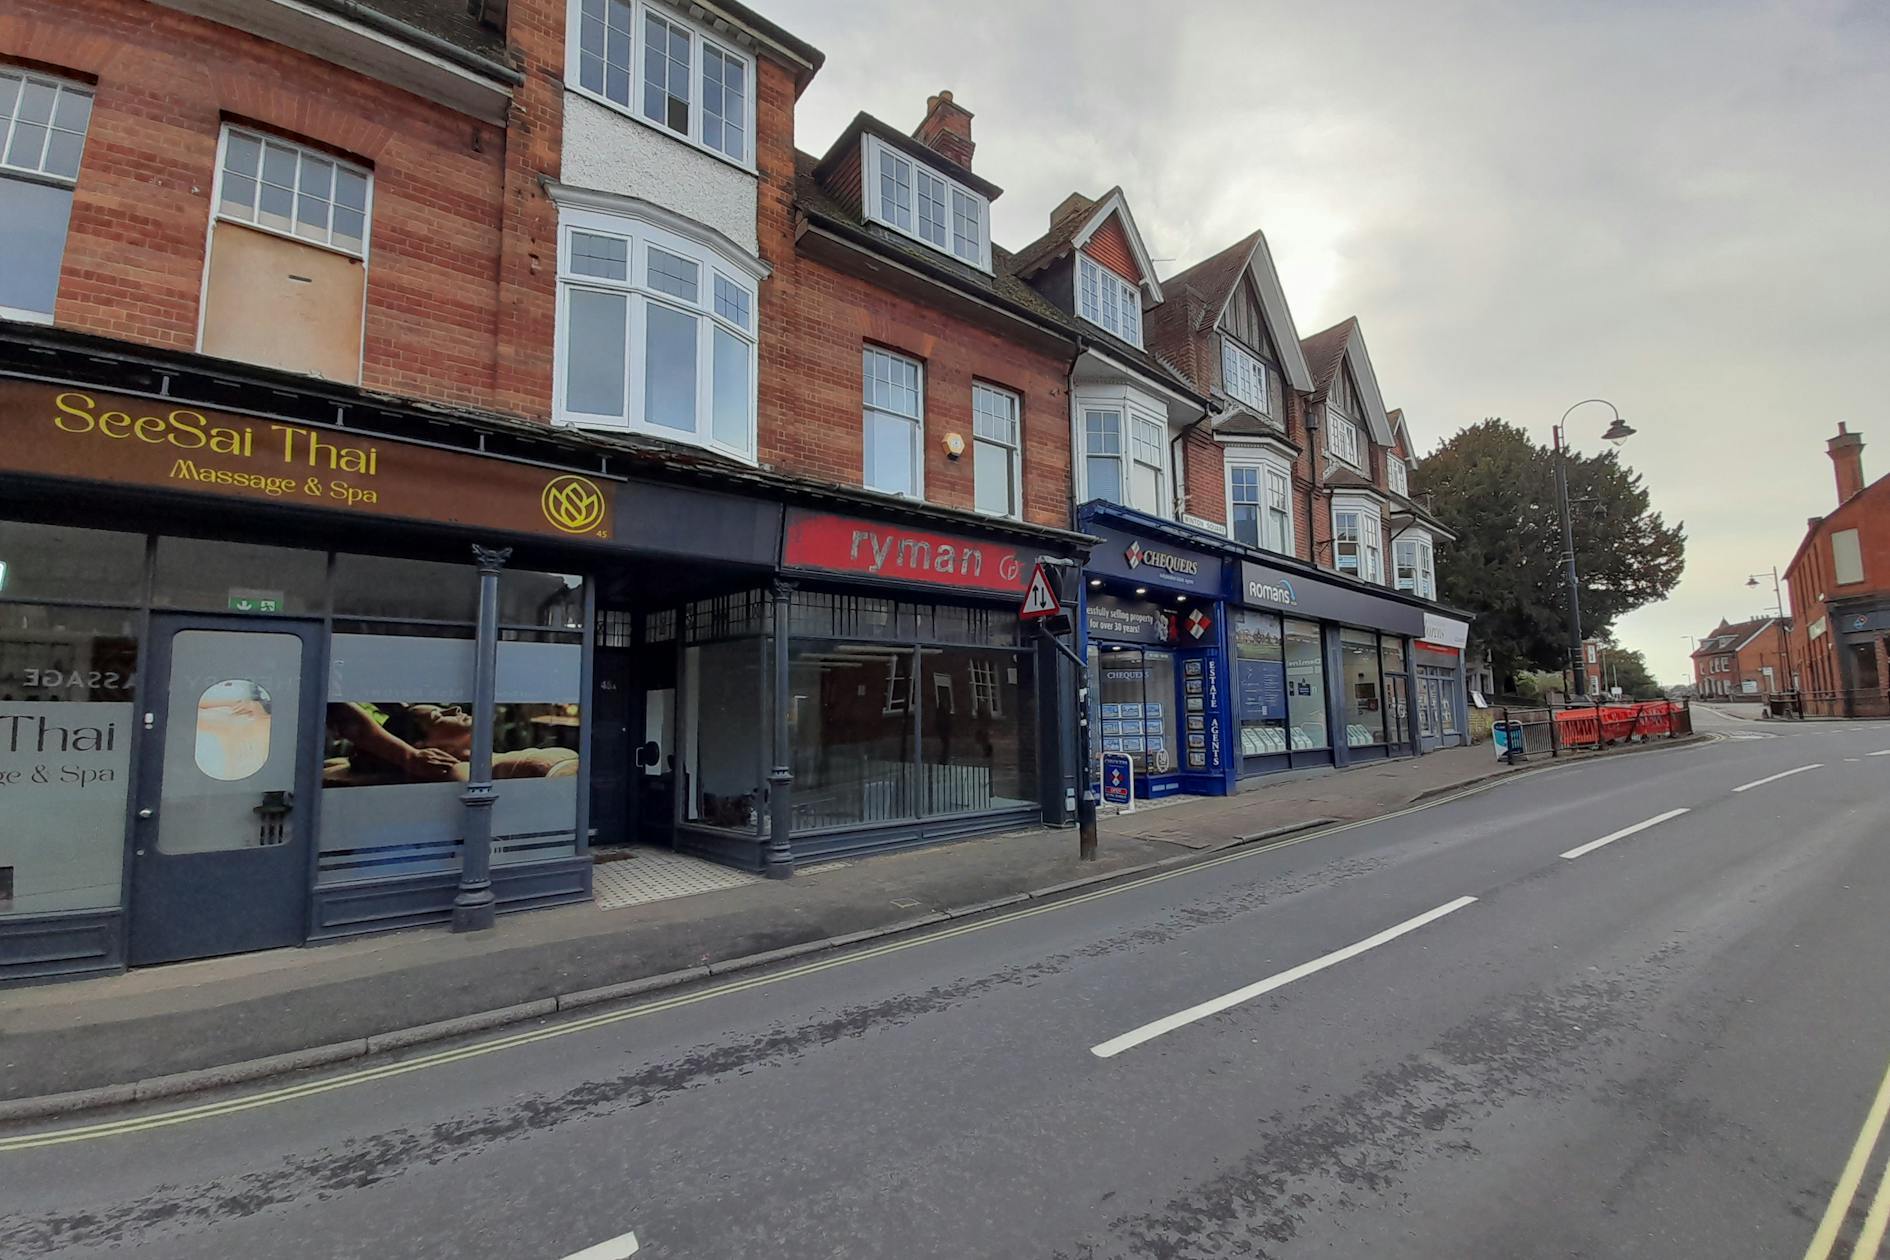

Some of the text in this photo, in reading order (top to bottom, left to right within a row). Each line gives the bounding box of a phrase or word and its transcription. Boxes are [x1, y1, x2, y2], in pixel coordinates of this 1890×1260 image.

[54, 392, 376, 475] SeeSai Thai
[169, 459, 377, 505] Massage & Spa
[596, 530, 608, 538] 45
[851, 530, 982, 577] ryman
[1143, 550, 1198, 575] CHEQUERS
[1086, 606, 1153, 625] essfully selling property
[1089, 618, 1140, 634] for over 30 years!
[1107, 671, 1150, 680] CHEQUES
[1209, 661, 1218, 708] ESTATE
[0, 715, 115, 752] Thai
[1211, 718, 1220, 766] AGENTS
[31, 764, 48, 784] &
[60, 764, 115, 788] Spa
